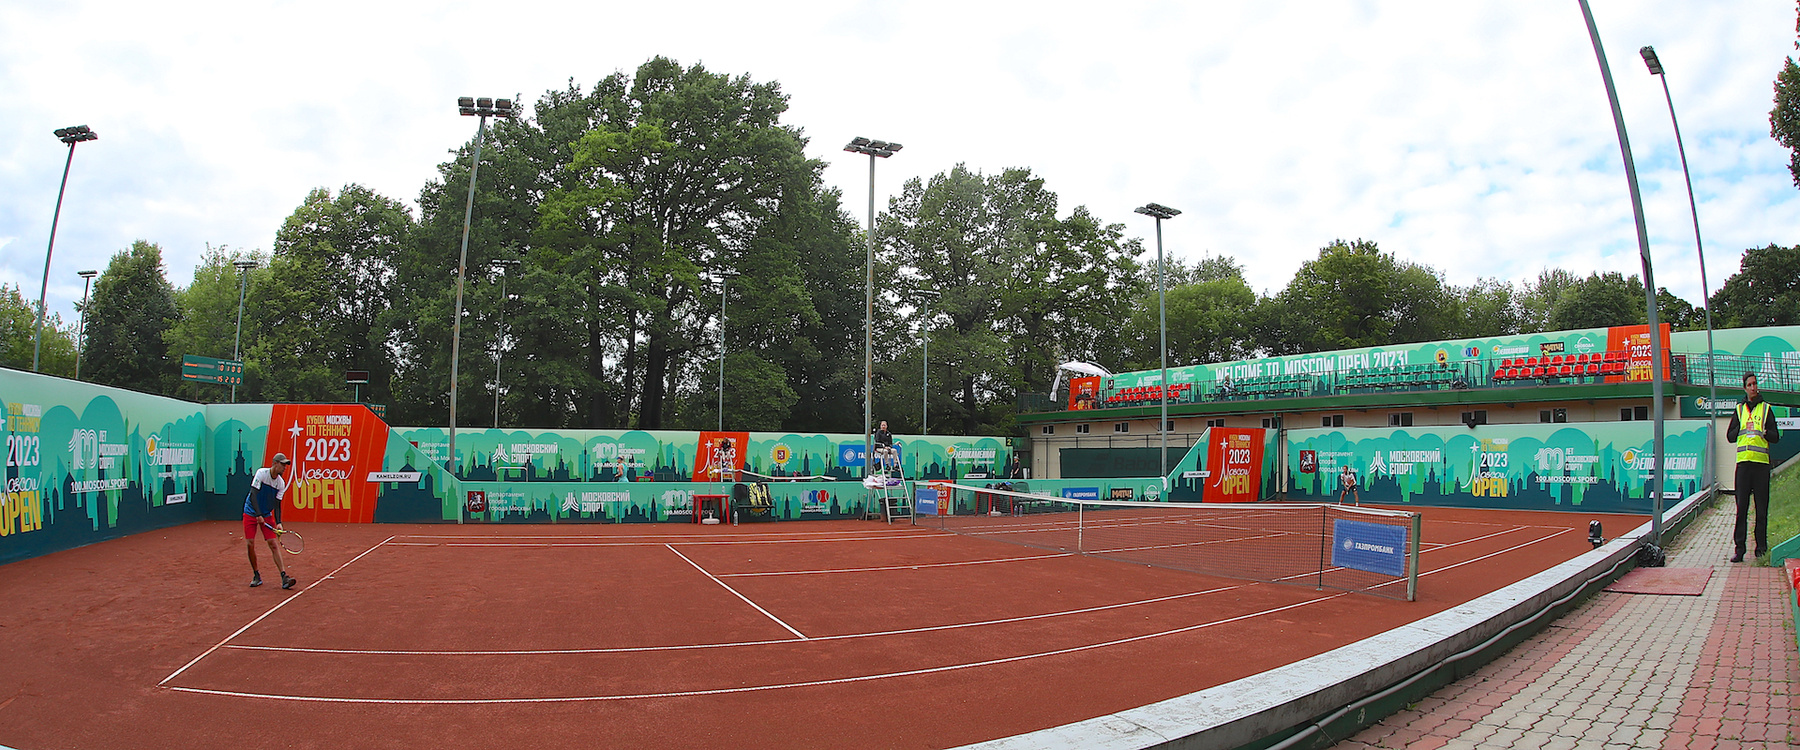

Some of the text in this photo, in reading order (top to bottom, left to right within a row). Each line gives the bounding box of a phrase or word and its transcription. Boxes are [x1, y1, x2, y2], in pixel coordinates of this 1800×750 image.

[1216, 364, 1262, 382] WELCOME
[1266, 361, 1279, 379] TO
[1285, 356, 1334, 377] MOSCOW
[1339, 353, 1369, 374] OPEN
[1373, 350, 1408, 370] 2023!
[306, 415, 352, 424] КУБОК МОСКВЫ
[306, 425, 352, 436] ПО ТЕННИСУ
[68, 429, 97, 470] 100
[305, 438, 351, 461] 2023
[511, 441, 558, 453] МОСКОВСКИЙ
[1006, 438, 1012, 446] 2
[6, 434, 40, 467] 2023
[592, 442, 618, 459] 100
[714, 448, 736, 459] 23
[1229, 449, 1250, 464] 2023
[1389, 448, 1440, 462] МОСКОВСКИЙ
[511, 454, 533, 463] СПОРТ
[1480, 452, 1508, 467] 2023
[1533, 447, 1564, 470] 100
[1620, 448, 1697, 470] БЕЛОМЕННАЯ
[1389, 463, 1413, 474] СПОРТ
[70, 478, 128, 493] 100.MOSCOW.SPORT
[1223, 475, 1250, 495] OPEN
[1472, 478, 1508, 496] OPEN
[293, 478, 351, 509] OPEN
[581, 490, 630, 502] МОСКОВСКИЙ
[661, 490, 686, 507] 100
[0, 490, 42, 537] OPEN
[581, 502, 605, 512] СПОРТ
[1355, 542, 1394, 554] ГАЗПРОМБАНК
